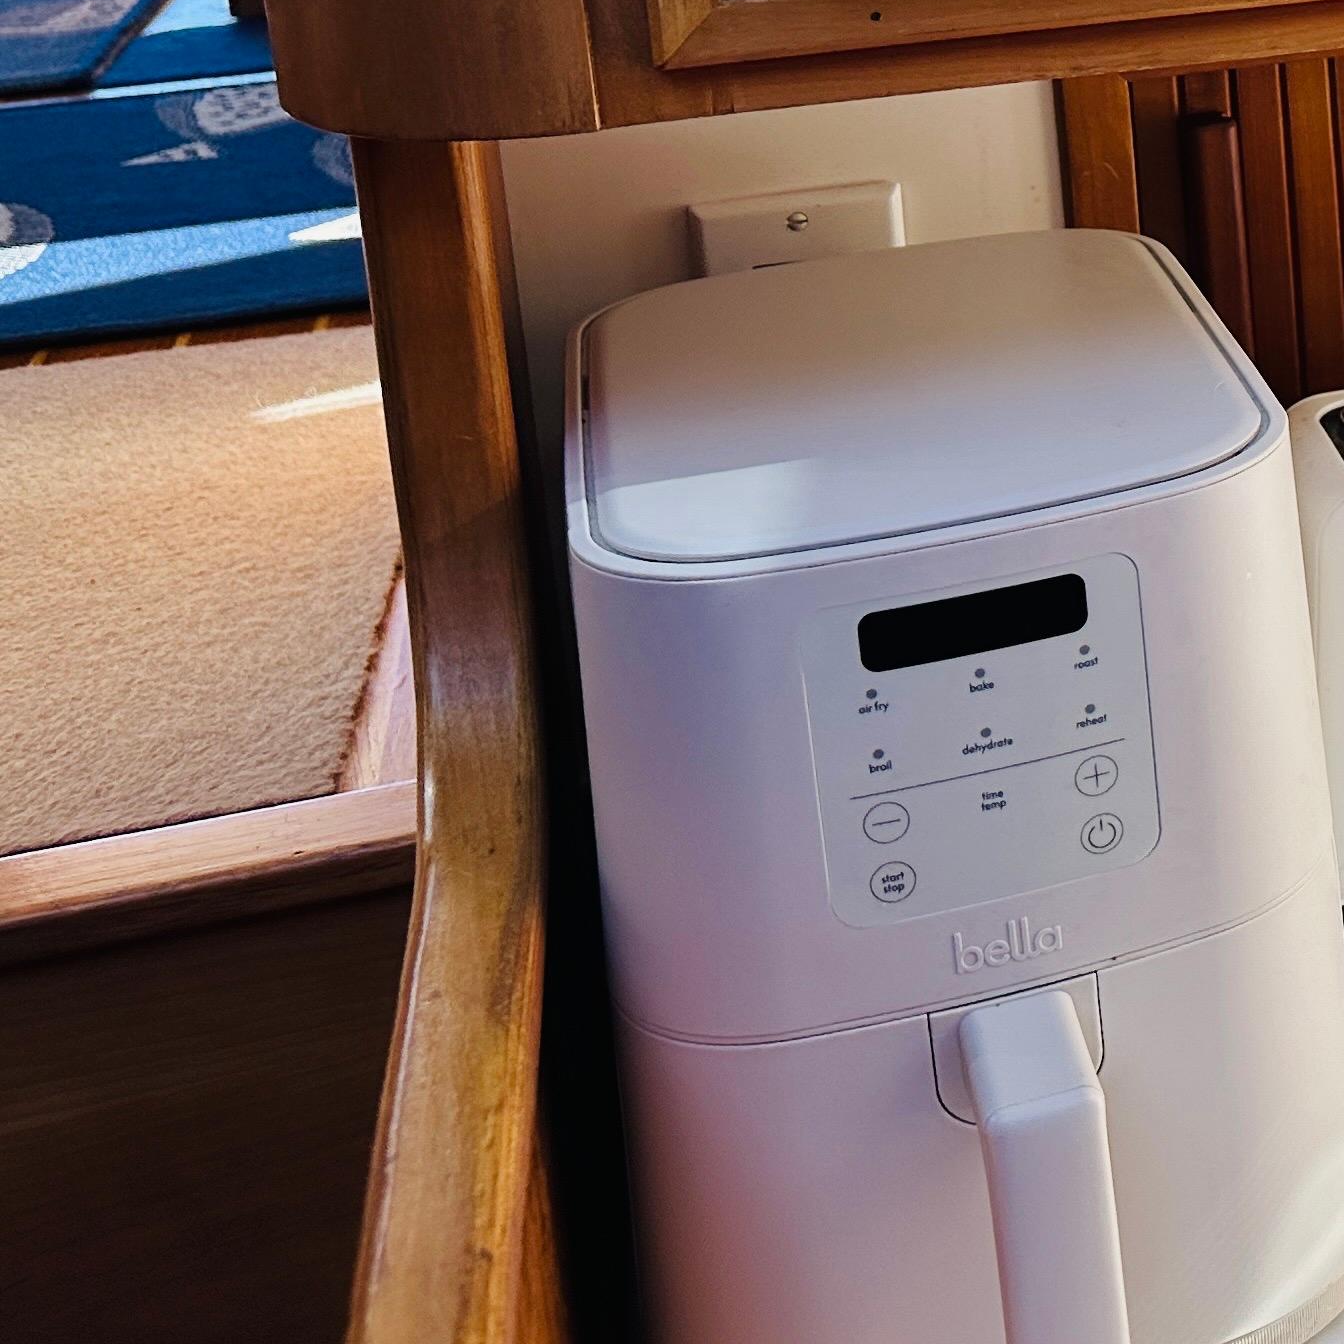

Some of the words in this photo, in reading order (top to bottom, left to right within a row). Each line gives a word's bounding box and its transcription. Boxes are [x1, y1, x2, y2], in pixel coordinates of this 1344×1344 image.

[1074, 657, 1099, 670] roast
[969, 680, 995, 693] bake
[858, 705, 872, 715] air
[873, 701, 889, 713] fry
[1076, 714, 1107, 729] reheat
[962, 737, 1013, 756] dehydrate
[869, 759, 892, 774] broil
[981, 790, 1004, 801] time
[981, 799, 1007, 812] temp
[881, 871, 904, 884] start
[883, 882, 905, 895] stop
[952, 916, 1064, 975] bella
